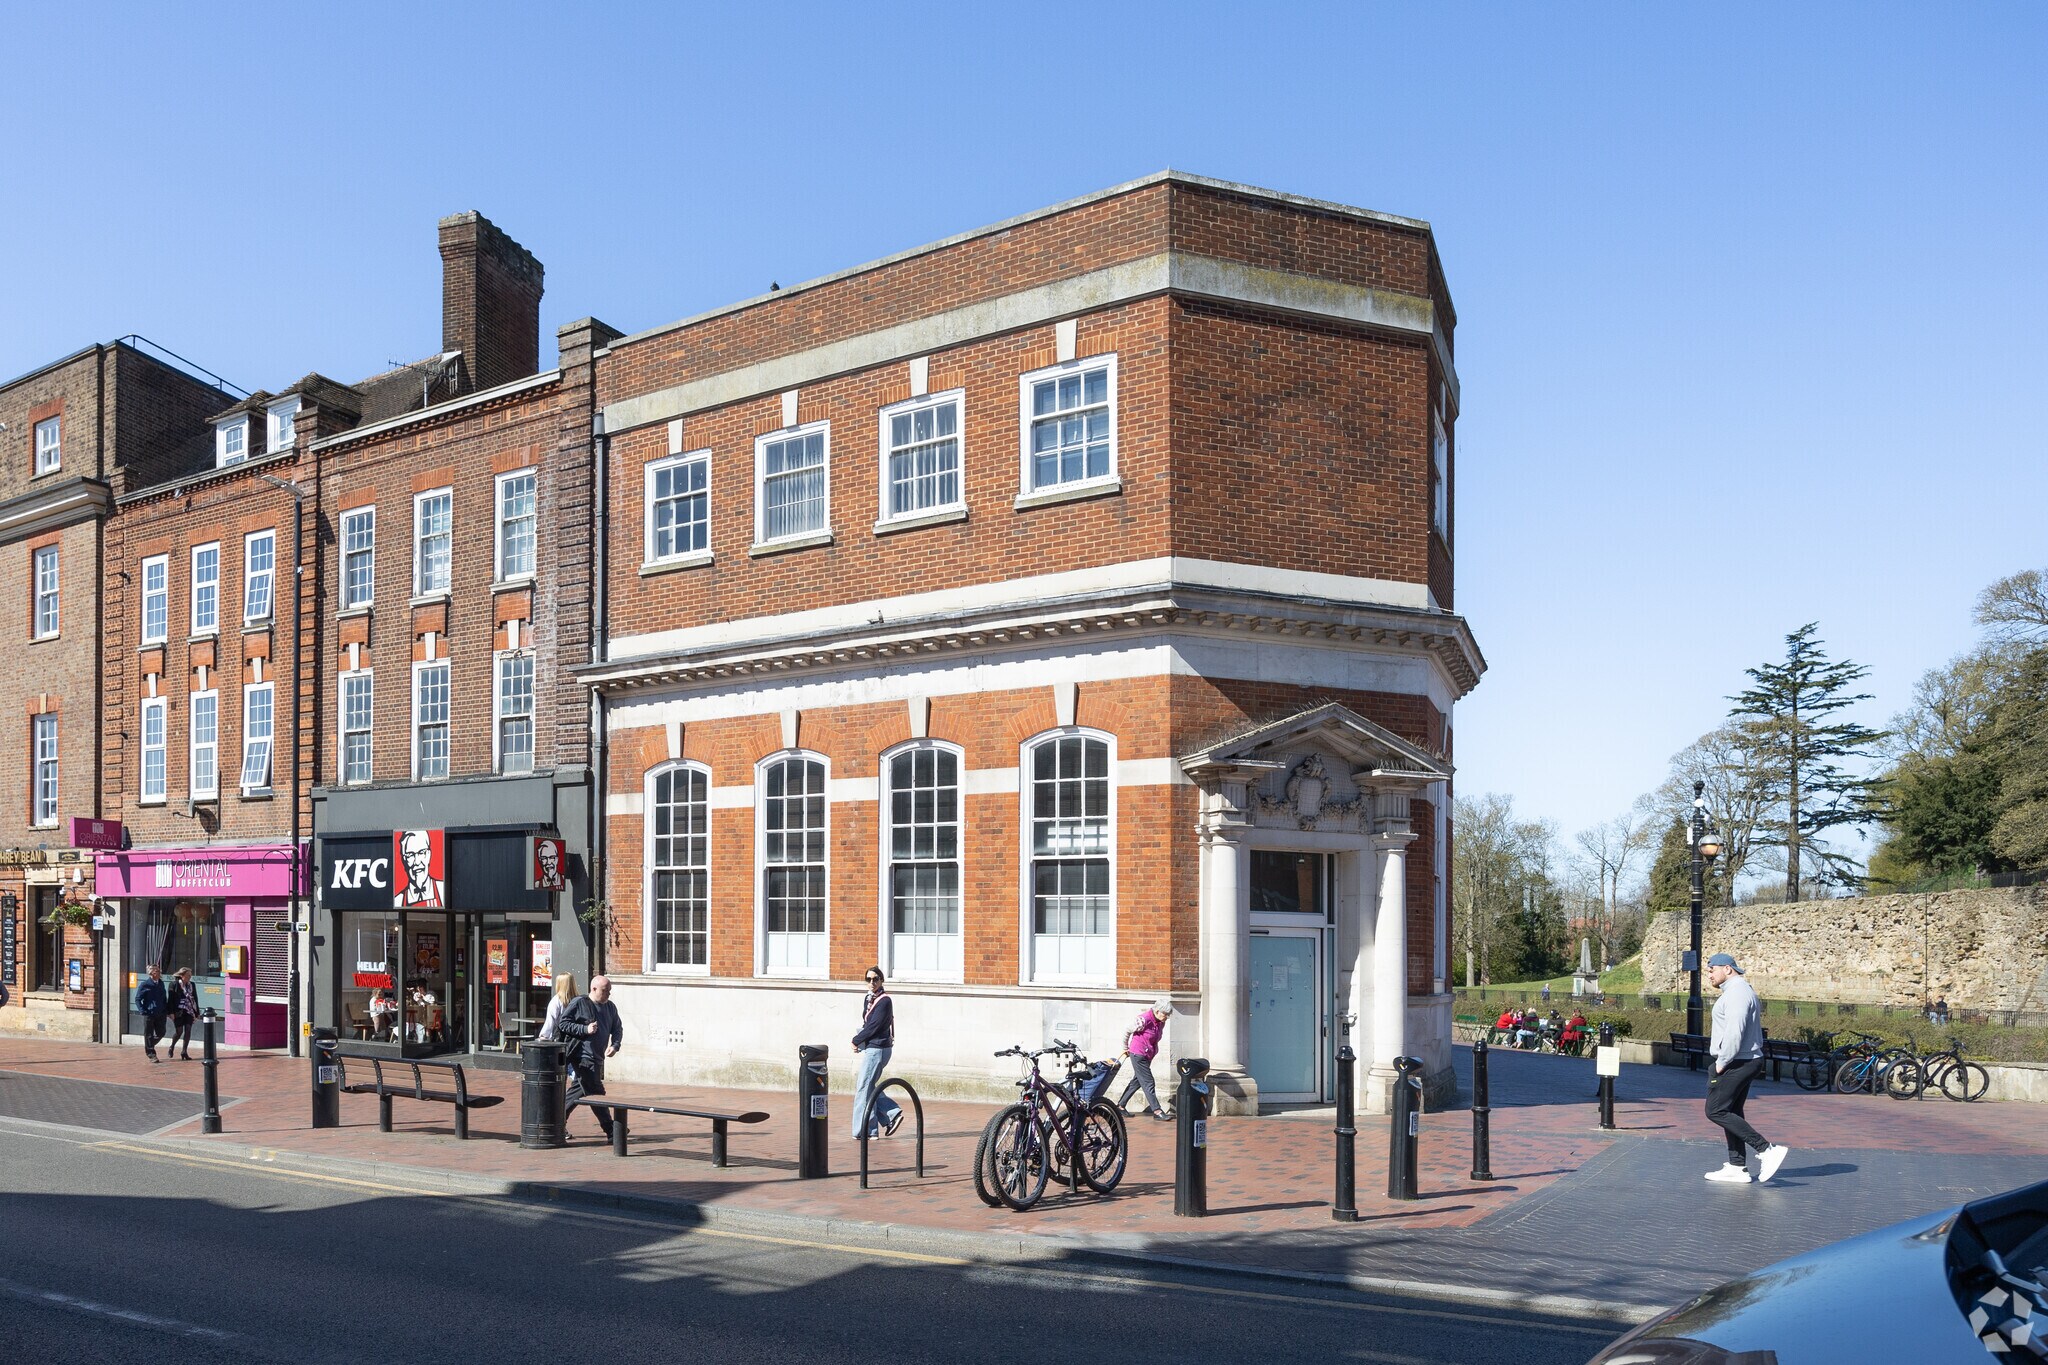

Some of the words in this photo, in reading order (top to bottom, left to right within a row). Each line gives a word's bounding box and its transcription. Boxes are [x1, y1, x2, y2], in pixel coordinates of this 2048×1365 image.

[80, 832, 116, 843] ORIENTAL
[21, 850, 41, 862] BEAN
[175, 859, 231, 878] ORIENTAL
[331, 858, 388, 888] KFC
[357, 961, 385, 972] HELLO
[353, 973, 393, 988] TONBRIDGE
[304, 1024, 309, 1035] H
